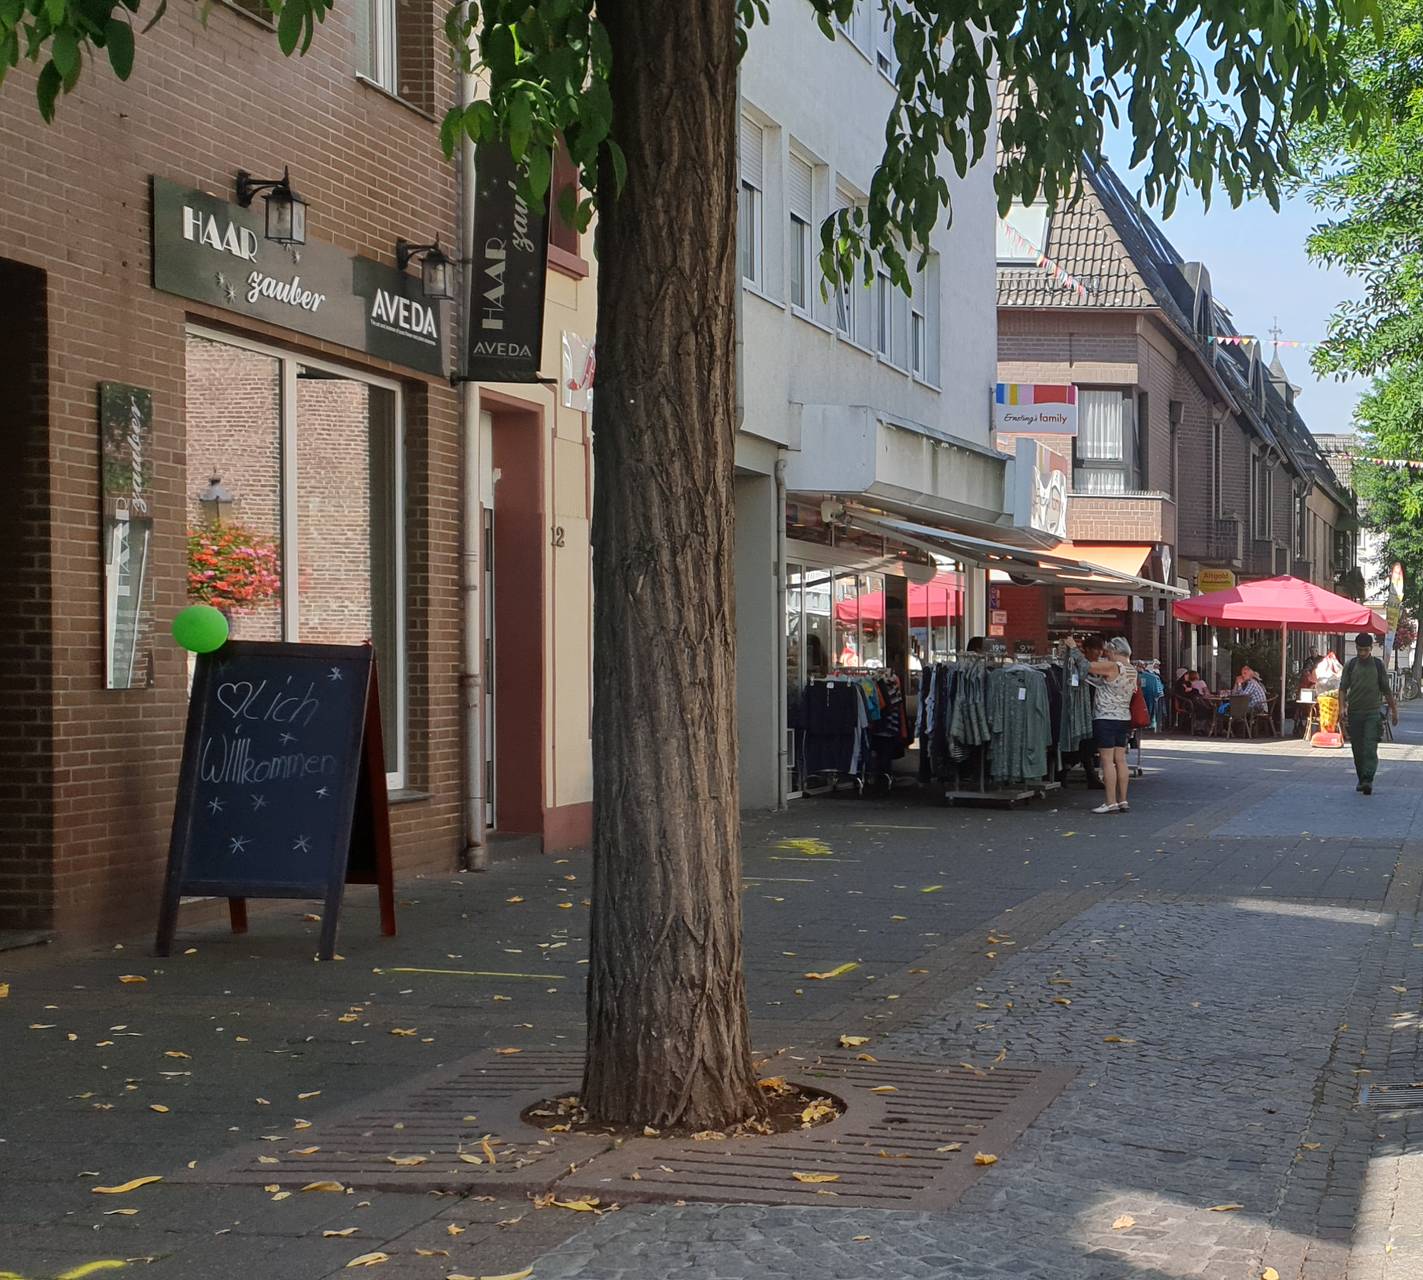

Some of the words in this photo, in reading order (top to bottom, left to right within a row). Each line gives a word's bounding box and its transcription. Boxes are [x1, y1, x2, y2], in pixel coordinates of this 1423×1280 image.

[183, 205, 258, 264] HAAR
[247, 271, 326, 313] zauber
[482, 237, 507, 329] HAAR
[372, 288, 437, 339] AVEDA
[473, 341, 532, 357] AVEDA
[1039, 412, 1068, 424] family
[131, 395, 147, 514] zauber
[551, 526, 565, 548] 12
[201, 725, 337, 784] Willkommen
